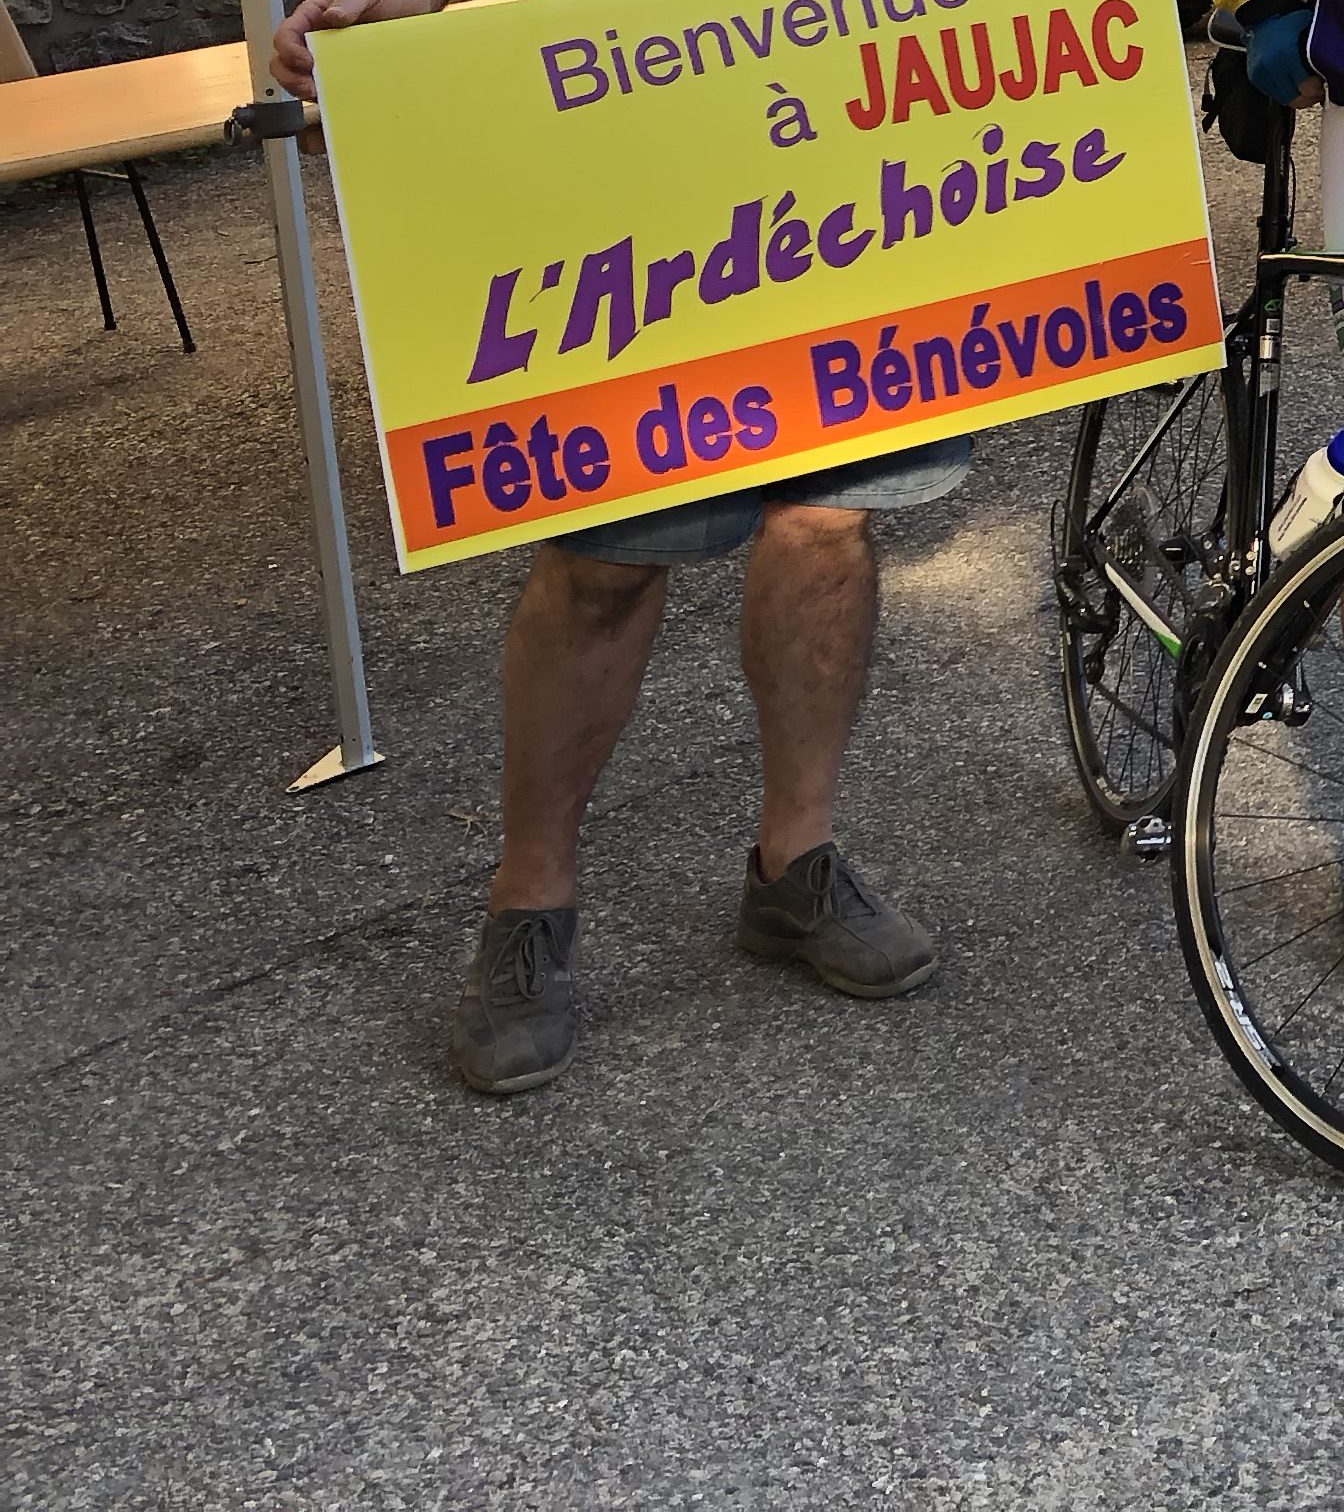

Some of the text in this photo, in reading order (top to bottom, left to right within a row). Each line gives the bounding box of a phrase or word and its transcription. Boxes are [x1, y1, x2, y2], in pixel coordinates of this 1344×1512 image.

[768, 84, 817, 148] à
[466, 124, 1126, 384] L'Ardéchoise
[422, 279, 1188, 529] Fête des Bénévoles
